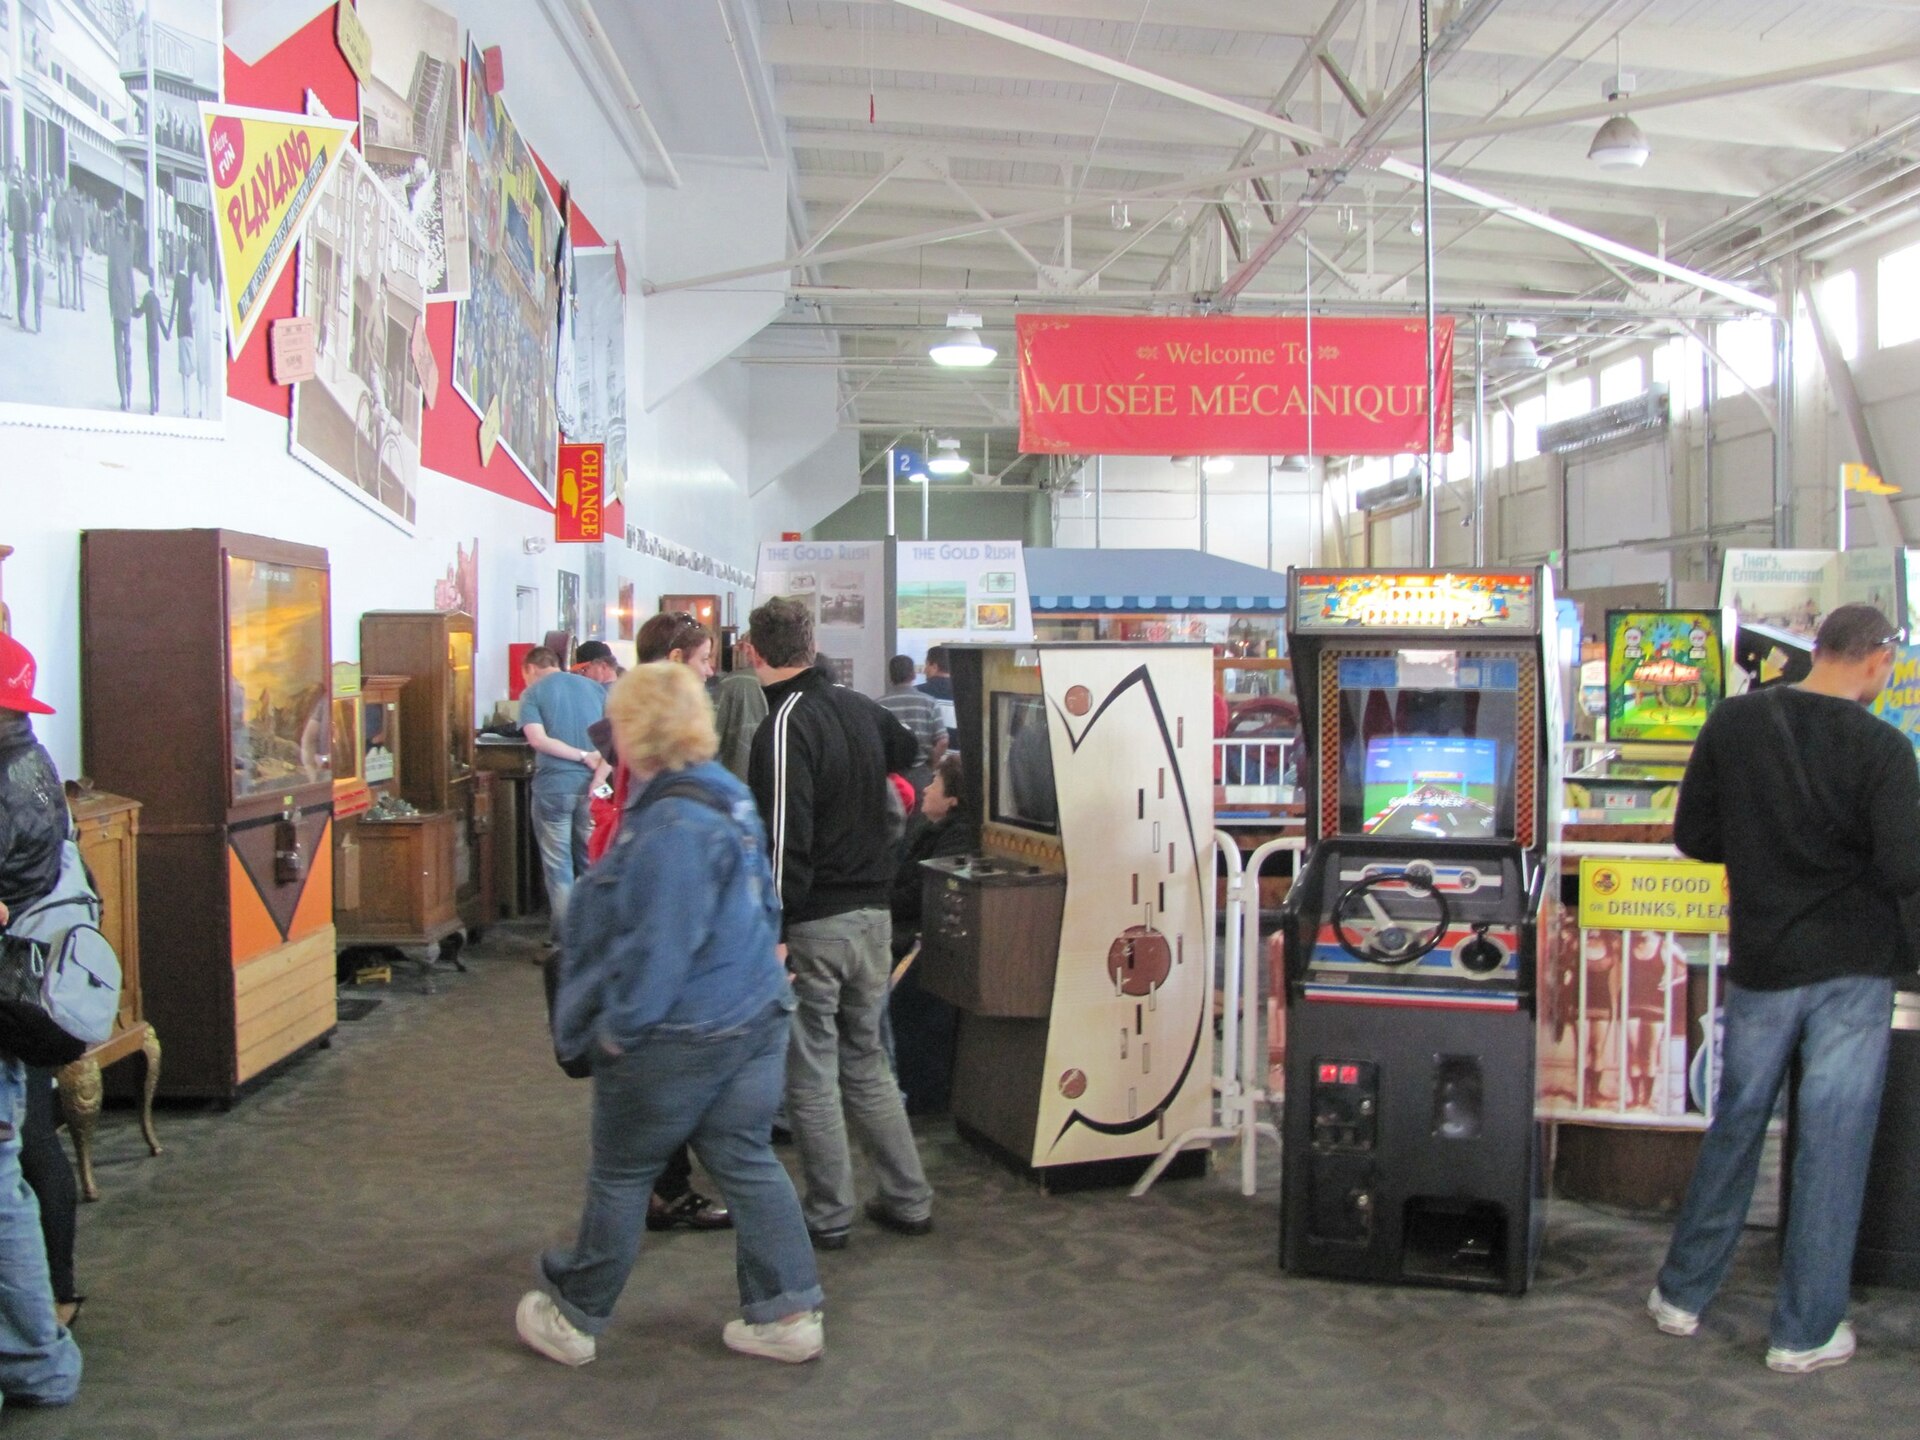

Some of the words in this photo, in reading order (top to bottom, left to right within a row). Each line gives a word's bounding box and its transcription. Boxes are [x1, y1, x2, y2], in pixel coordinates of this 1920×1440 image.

[211, 131, 229, 155] Have
[218, 146, 236, 181] FUN
[227, 127, 312, 254] PLAYLAND
[1165, 341, 1276, 365] Welcome
[1282, 342, 1313, 365] To
[1037, 372, 1178, 416] MUSÉE
[900, 454, 911, 472] 2
[581, 449, 599, 537] CHANGE
[767, 547, 790, 560] THE
[793, 544, 833, 560] GOLD
[839, 545, 870, 560] RUSH
[913, 547, 935, 560] THE
[940, 543, 980, 560] GOLD
[984, 544, 1016, 560] RUSH
[1631, 877, 1656, 892] NO
[1661, 877, 1710, 893] FOOD
[1589, 903, 1604, 912] OR
[1608, 901, 1682, 919] DRINKS,
